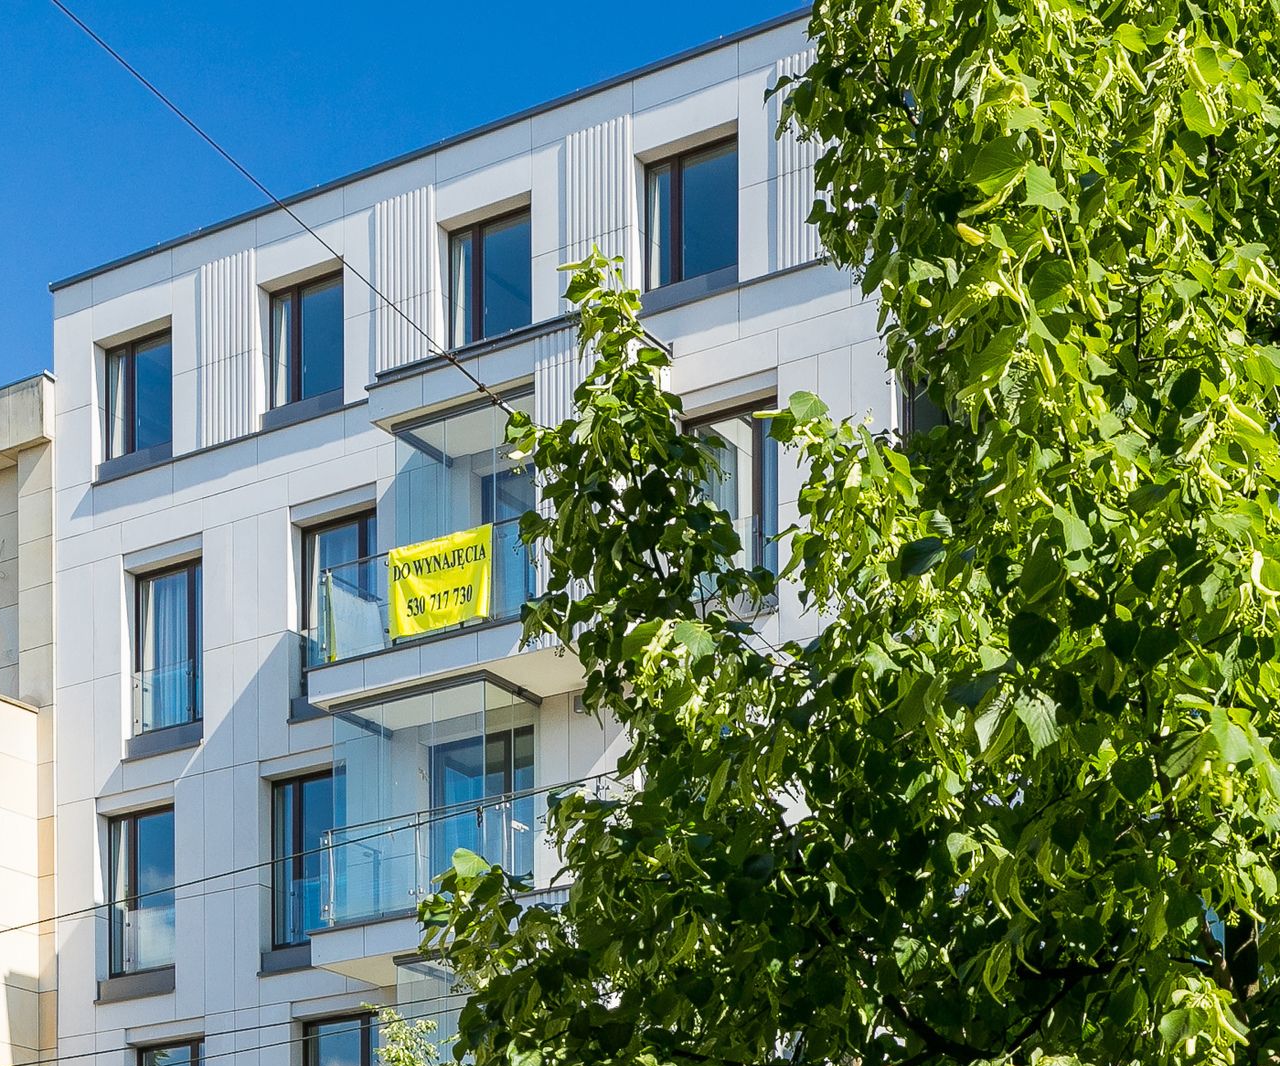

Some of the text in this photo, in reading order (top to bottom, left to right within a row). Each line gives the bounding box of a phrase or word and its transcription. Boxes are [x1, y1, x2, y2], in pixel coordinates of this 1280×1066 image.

[393, 543, 486, 582] DO WYNAJĘCIA
[407, 584, 472, 617] 530 717 730
